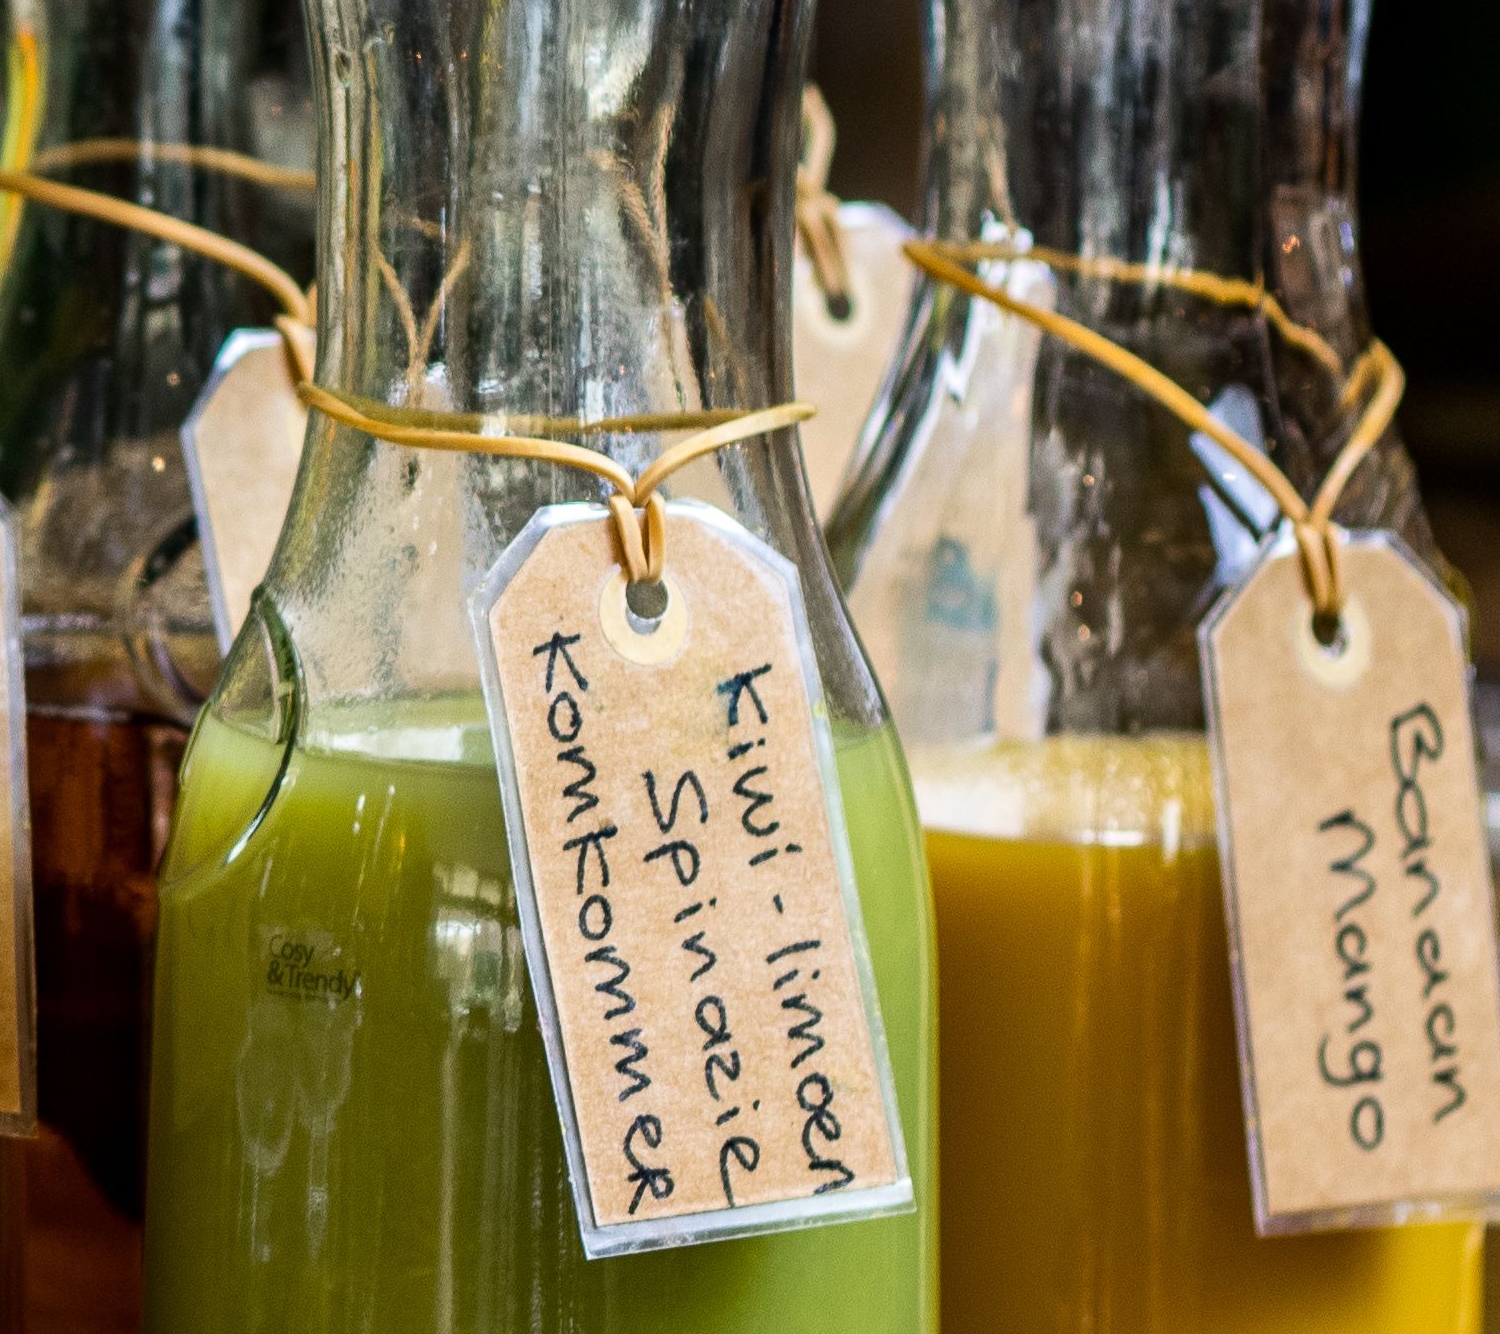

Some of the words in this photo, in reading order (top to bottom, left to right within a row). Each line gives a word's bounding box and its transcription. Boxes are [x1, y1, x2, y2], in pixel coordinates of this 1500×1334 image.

[269, 934, 315, 968] Cosy
[643, 769, 763, 1208] Spinazie
[1391, 702, 1467, 1124] Banaan
